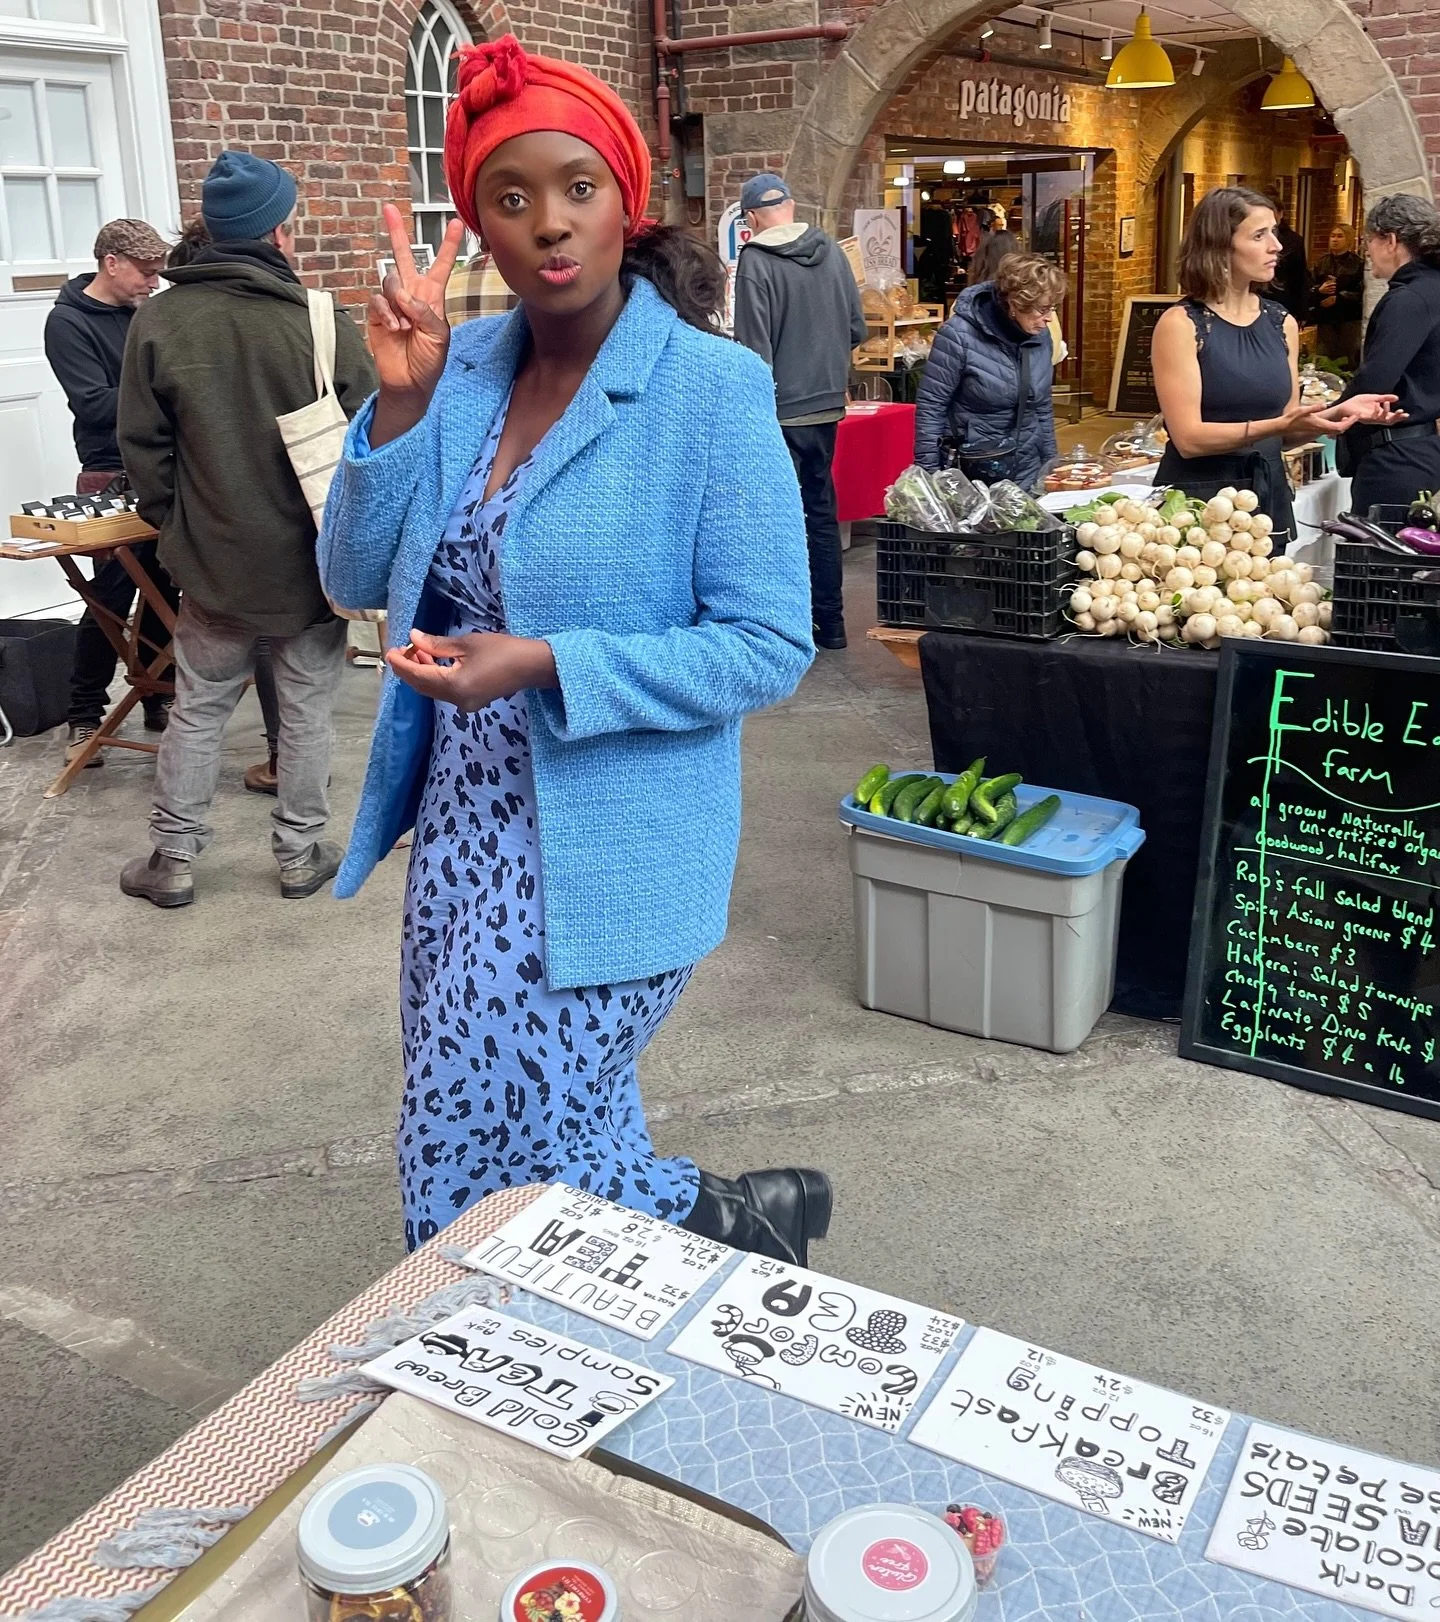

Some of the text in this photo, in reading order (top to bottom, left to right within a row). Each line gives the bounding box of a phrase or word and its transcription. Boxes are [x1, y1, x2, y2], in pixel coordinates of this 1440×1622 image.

[960, 78, 1071, 126] patagonia
[1270, 669, 1383, 742] Edible
[1300, 820, 1397, 849] un-certified
[1234, 894, 1278, 925] Spicy
[1291, 877, 1324, 900] fall
[1392, 900, 1433, 928] blend
[1287, 981, 1328, 1007] toms
[1321, 1014, 1366, 1041] Dino
[1365, 1062, 1373, 1072] a
[1389, 1063, 1404, 1084] lb
[563, 1185, 728, 1253] DELICIOUS HOT OR CHILLED
[573, 1200, 602, 1217] $12
[529, 1219, 649, 1291] TEA
[680, 1243, 720, 1264] $24
[760, 1260, 785, 1275] $12
[476, 1236, 660, 1330] BEAUTIFUL
[661, 1284, 690, 1300] $32
[464, 1322, 496, 1336] Ask
[762, 1279, 907, 1355] TEA
[930, 1315, 960, 1329] $24
[922, 1333, 949, 1348] $32
[508, 1329, 660, 1395] Samples
[395, 1361, 588, 1447] Cold Brew
[855, 1404, 900, 1421] NEW
[1006, 1367, 1195, 1469] Topping
[951, 1390, 1188, 1505] Breakfast
[1240, 1471, 1387, 1531] SEEDS
[1138, 1518, 1171, 1529] NEW
[867, 1565, 918, 1582] Gluten
[880, 1558, 910, 1570] Free
[1318, 1560, 1414, 1606] Dark
